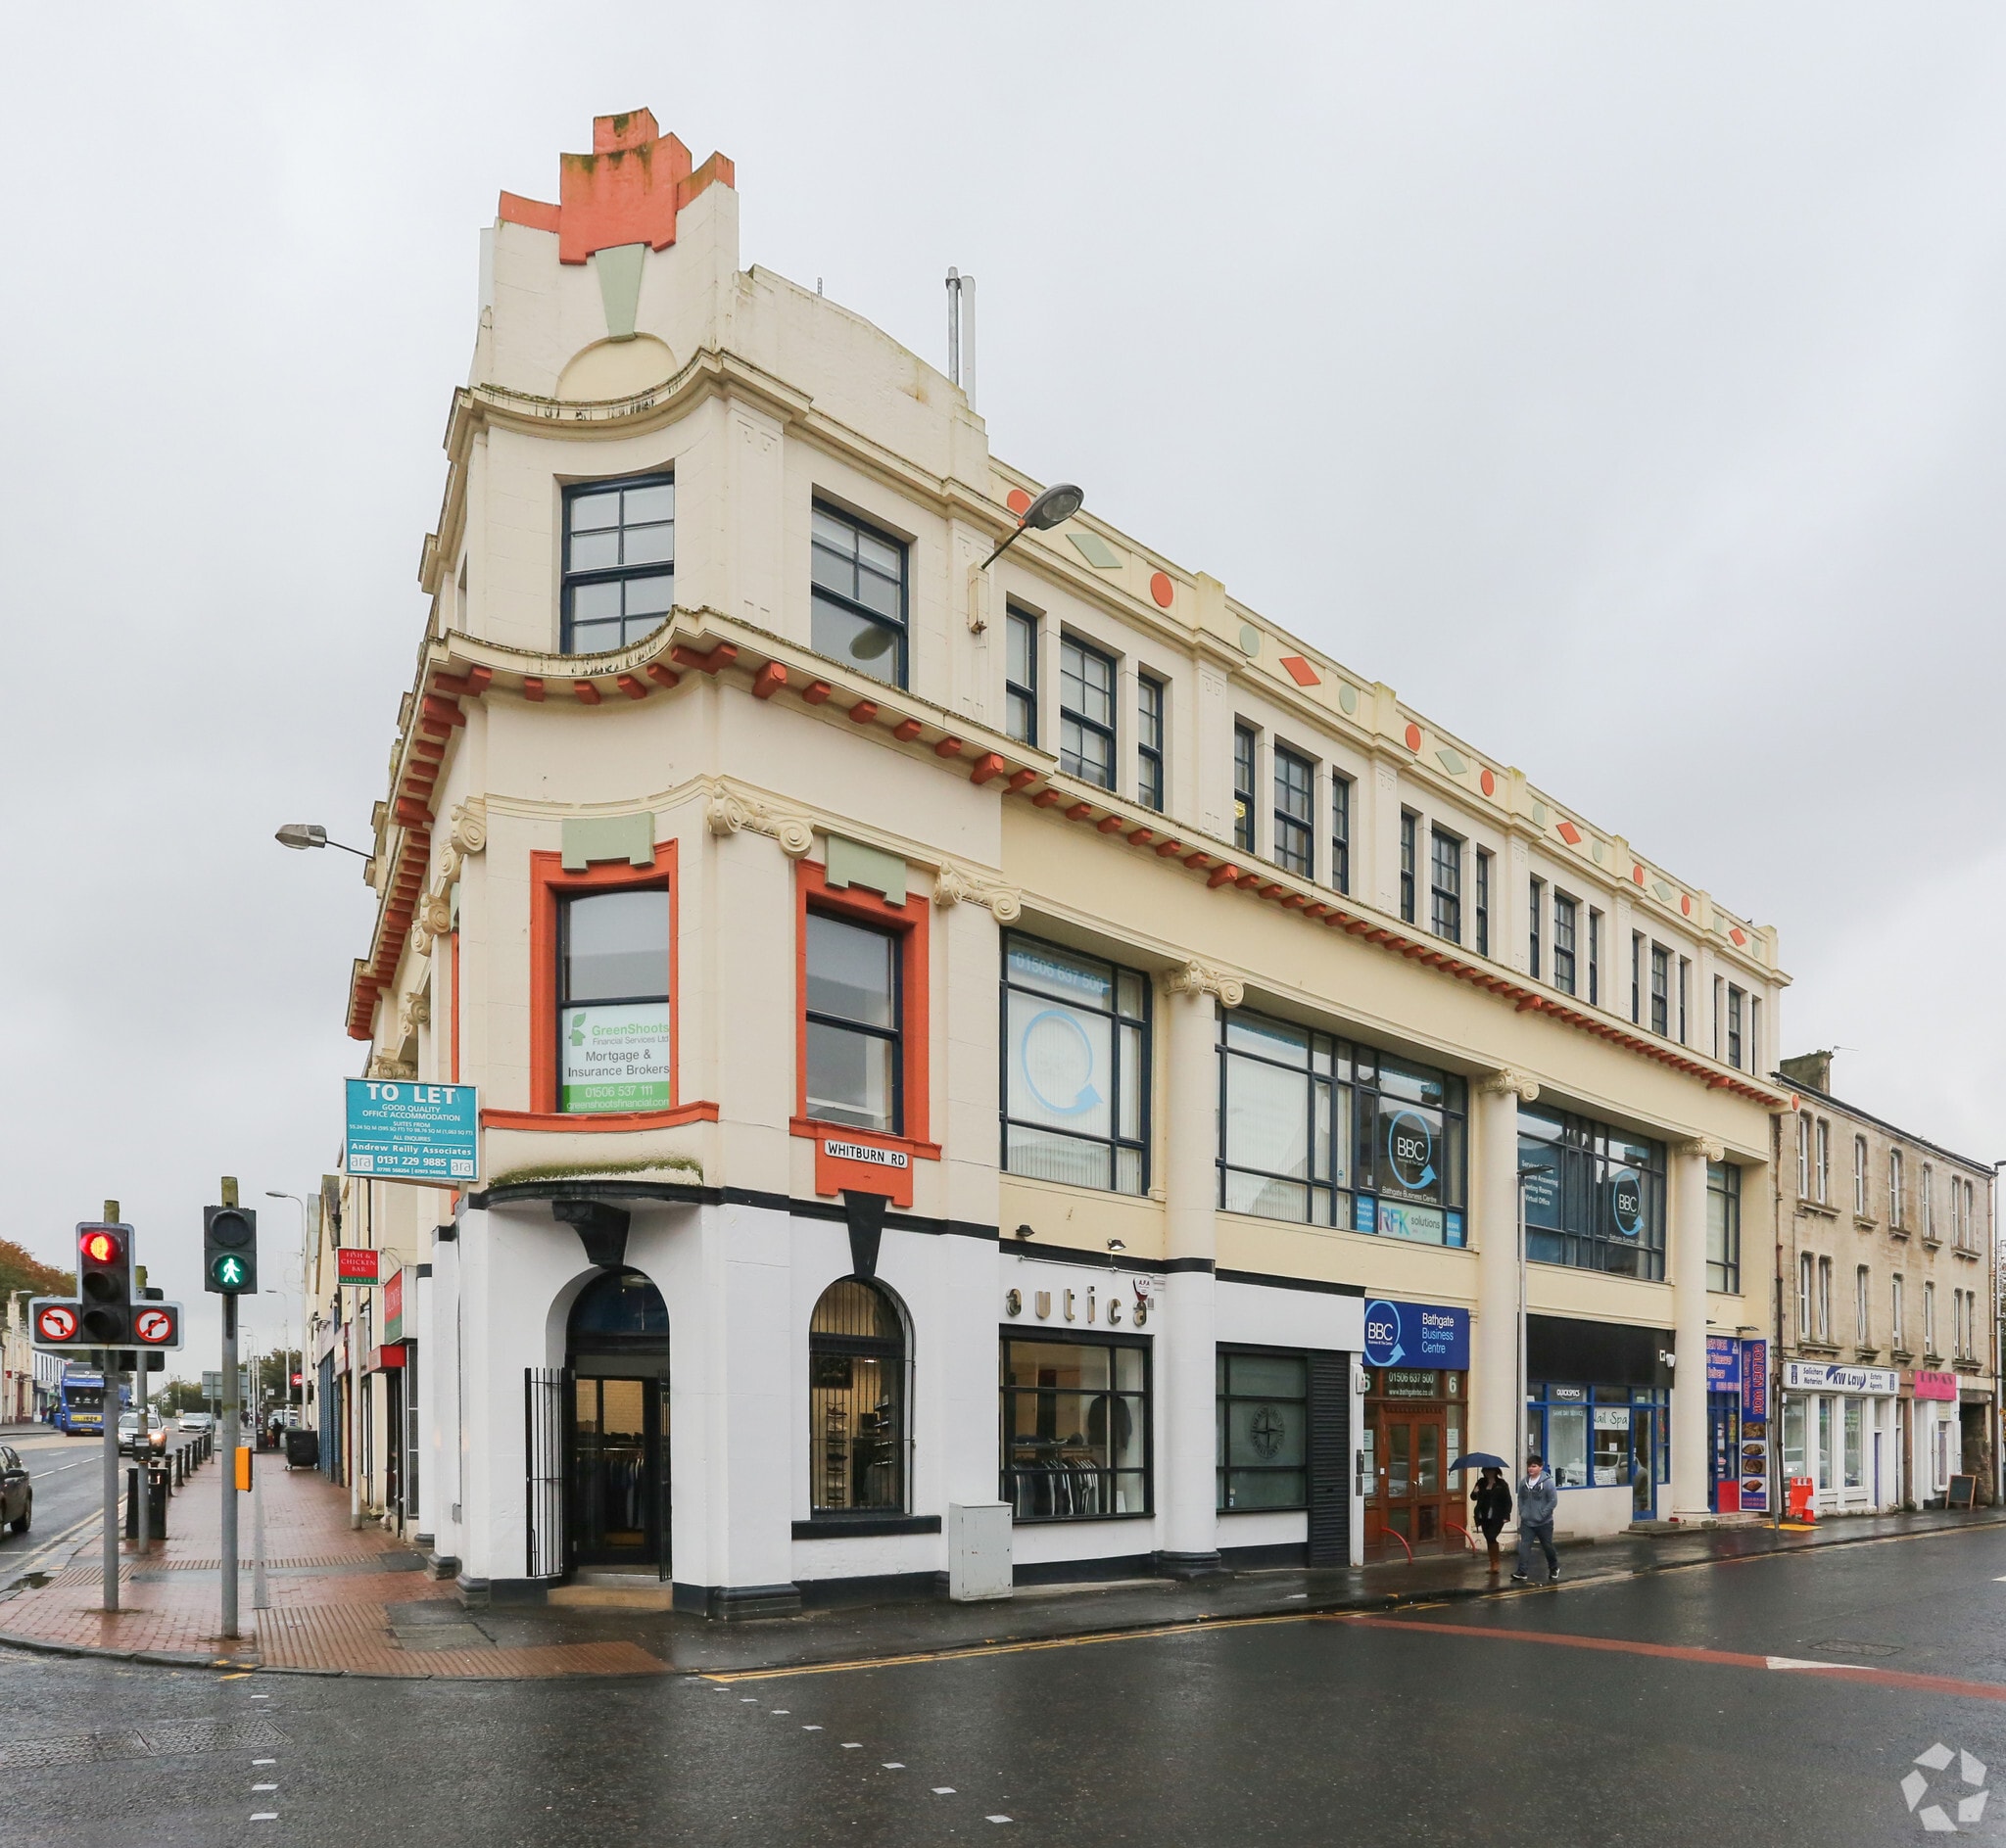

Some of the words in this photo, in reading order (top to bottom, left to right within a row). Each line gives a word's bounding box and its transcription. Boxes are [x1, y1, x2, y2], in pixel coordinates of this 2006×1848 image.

[1017, 952, 1054, 977] 01506
[1058, 967, 1079, 985] 637
[1082, 972, 1104, 993] 500
[592, 1023, 670, 1036] GreenShoots
[593, 1037, 623, 1046] Financial
[625, 1036, 655, 1045] Services
[586, 1051, 640, 1063] Mortgage
[644, 1049, 651, 1059] &
[568, 1067, 622, 1078] Insurance
[626, 1065, 670, 1075] Brokers
[366, 1083, 399, 1102] TO
[414, 1086, 456, 1104] LET
[585, 1087, 615, 1098] 01506
[618, 1086, 637, 1096] 537
[641, 1085, 653, 1095] 111
[382, 1104, 406, 1113] GOOD
[407, 1105, 441, 1114] QUALITY
[390, 1112, 460, 1122] ACCOMMODATION
[351, 1143, 389, 1153] Andrew
[393, 1144, 418, 1156] Reilly
[422, 1146, 471, 1156] Associates
[828, 1142, 884, 1162] WHITBURN
[891, 1153, 905, 1166] RD
[1397, 1137, 1425, 1161] BBC
[351, 1157, 371, 1167] ara
[377, 1155, 399, 1164] 0131
[402, 1157, 419, 1166] 229
[423, 1158, 447, 1167] 9885
[452, 1161, 471, 1172] ara
[1382, 1185, 1403, 1197] Bathgate
[1403, 1189, 1422, 1201] Business
[1423, 1193, 1437, 1204] Centre
[1619, 1194, 1637, 1212] BBC
[1379, 1206, 1409, 1236] RFK
[1411, 1215, 1441, 1230] solutions
[1422, 1312, 1455, 1329] Bathgate
[1368, 1322, 1393, 1341] BBC
[1422, 1328, 1454, 1341] Business
[1422, 1341, 1446, 1354] Centre
[1753, 1344, 1765, 1387] GOLDEN
[1803, 1367, 1823, 1376] Solicitors
[1388, 1372, 1408, 1383] 01506
[1409, 1373, 1421, 1383] 637
[1422, 1374, 1433, 1384] 500
[1803, 1377, 1823, 1386] Notaries
[1833, 1373, 1846, 1385] KW
[1848, 1373, 1863, 1387] Law
[1449, 1376, 1457, 1394] 6
[1752, 1388, 1765, 1415] WOK
[1610, 1412, 1628, 1429] Spa
